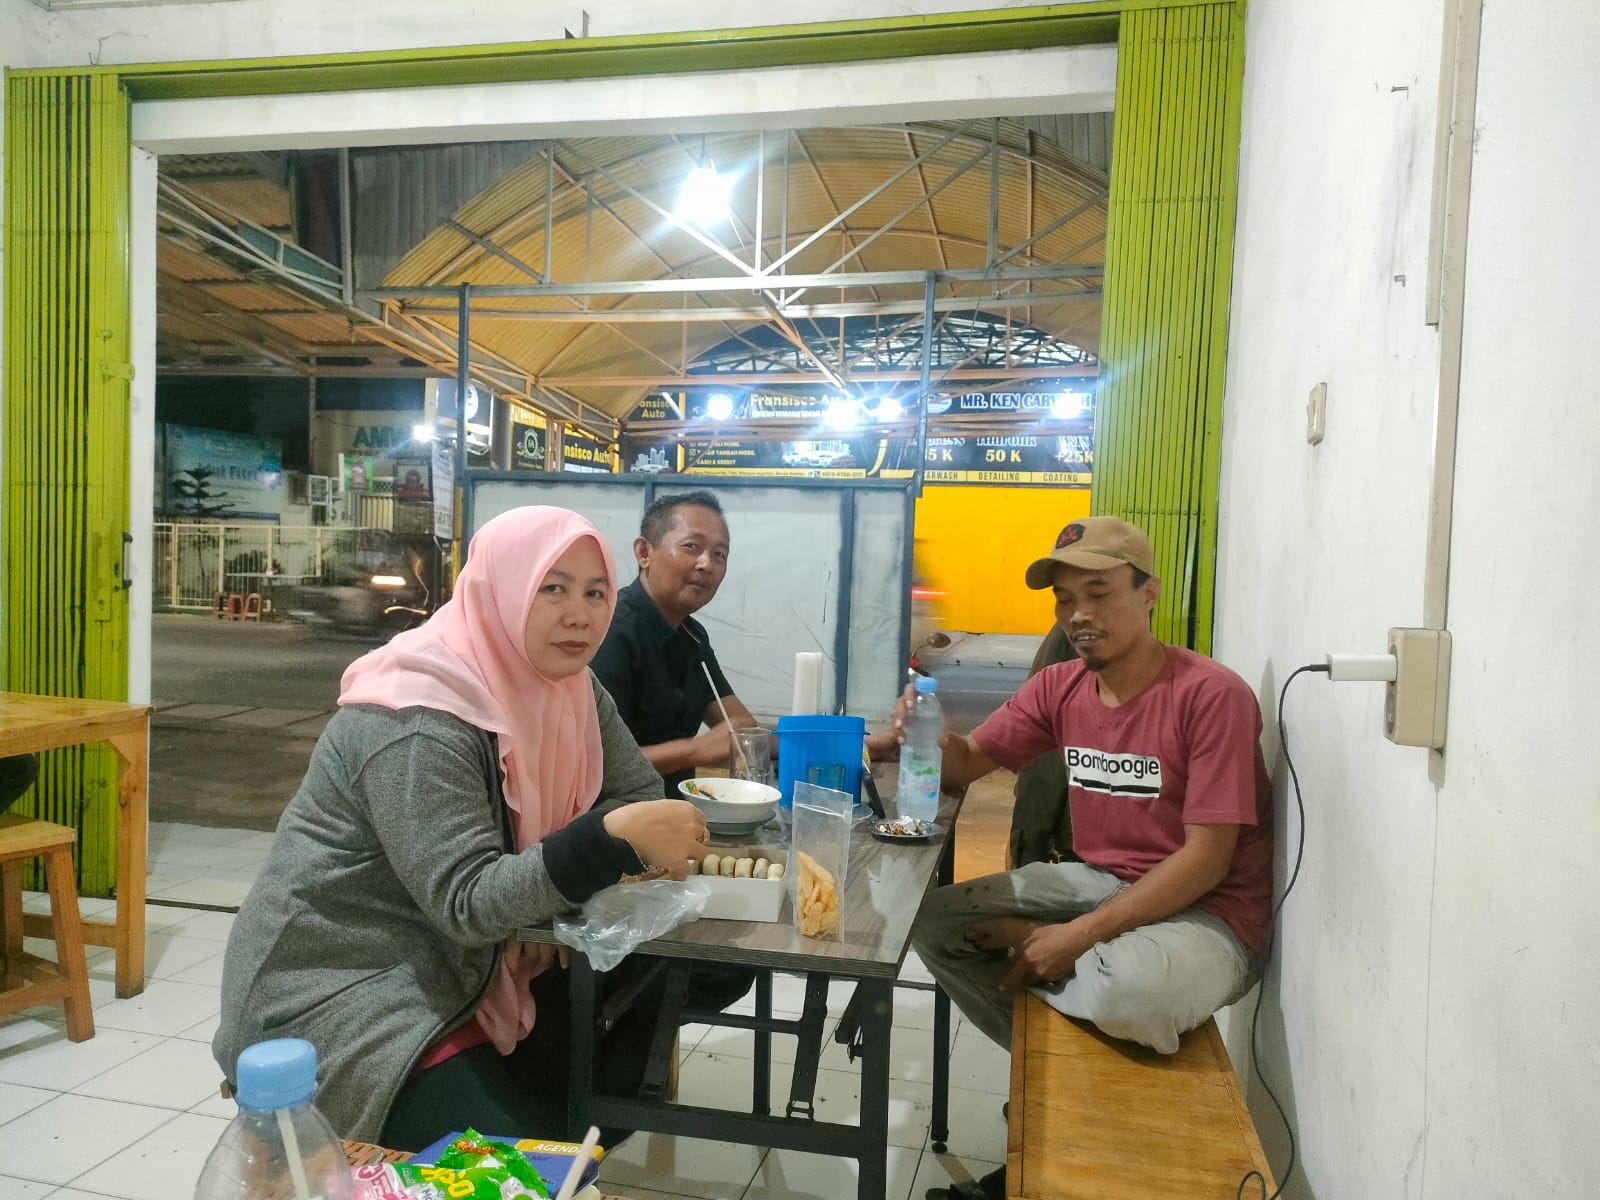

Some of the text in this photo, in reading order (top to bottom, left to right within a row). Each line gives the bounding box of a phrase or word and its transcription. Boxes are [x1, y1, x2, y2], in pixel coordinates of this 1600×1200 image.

[961, 393, 988, 409] MR.
[990, 393, 1020, 409] KEN
[641, 408, 666, 419] Auto
[942, 448, 953, 461] K
[985, 449, 1022, 462] 50 K
[925, 471, 958, 480] ARWASH
[978, 472, 1020, 481] DETAILING
[1043, 474, 1078, 482] COATING
[1067, 749, 1159, 779] Bomboogie
